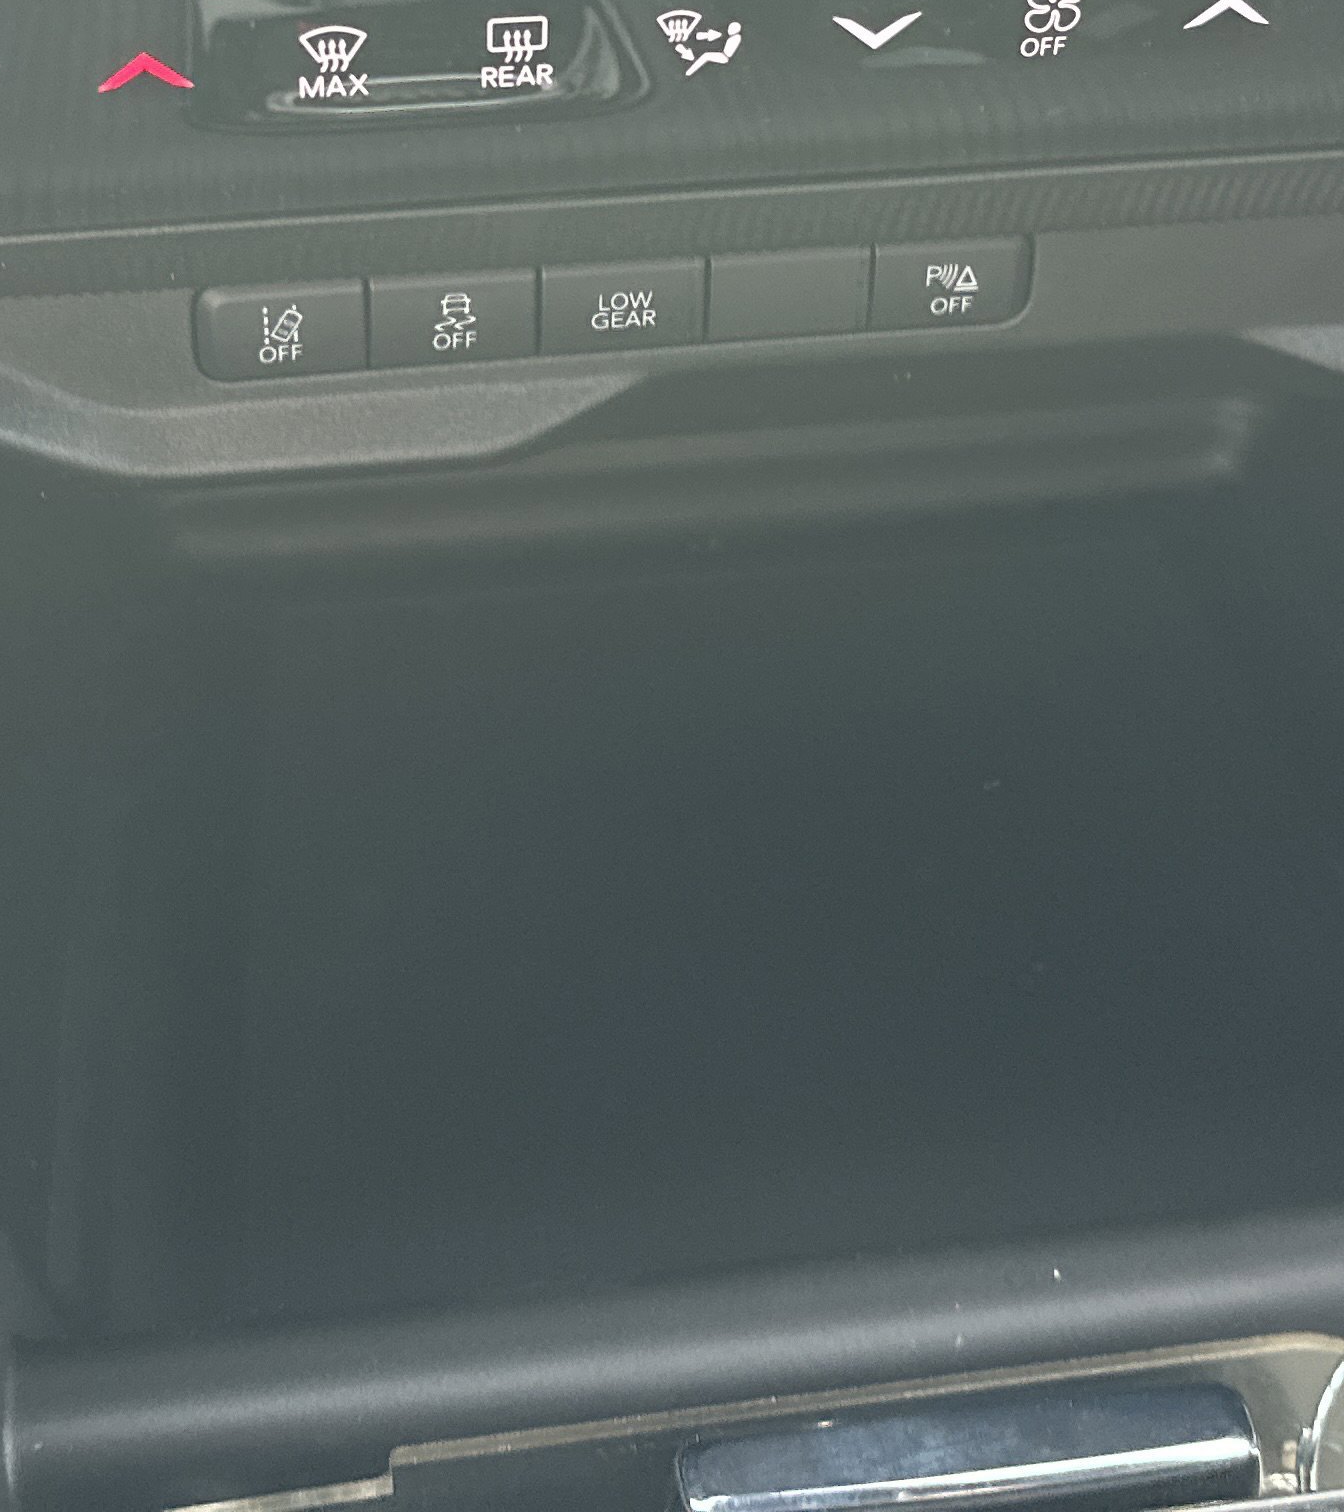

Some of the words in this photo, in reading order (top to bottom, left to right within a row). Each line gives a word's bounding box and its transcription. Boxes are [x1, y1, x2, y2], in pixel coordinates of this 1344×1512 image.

[1020, 35, 1067, 57] OFF
[298, 73, 369, 99] MAX
[480, 64, 553, 88] REAR
[598, 291, 653, 313] LOW
[930, 296, 973, 315] OFF
[591, 309, 656, 330] GEAR
[433, 331, 477, 351] OFF
[259, 344, 303, 364] OFF
